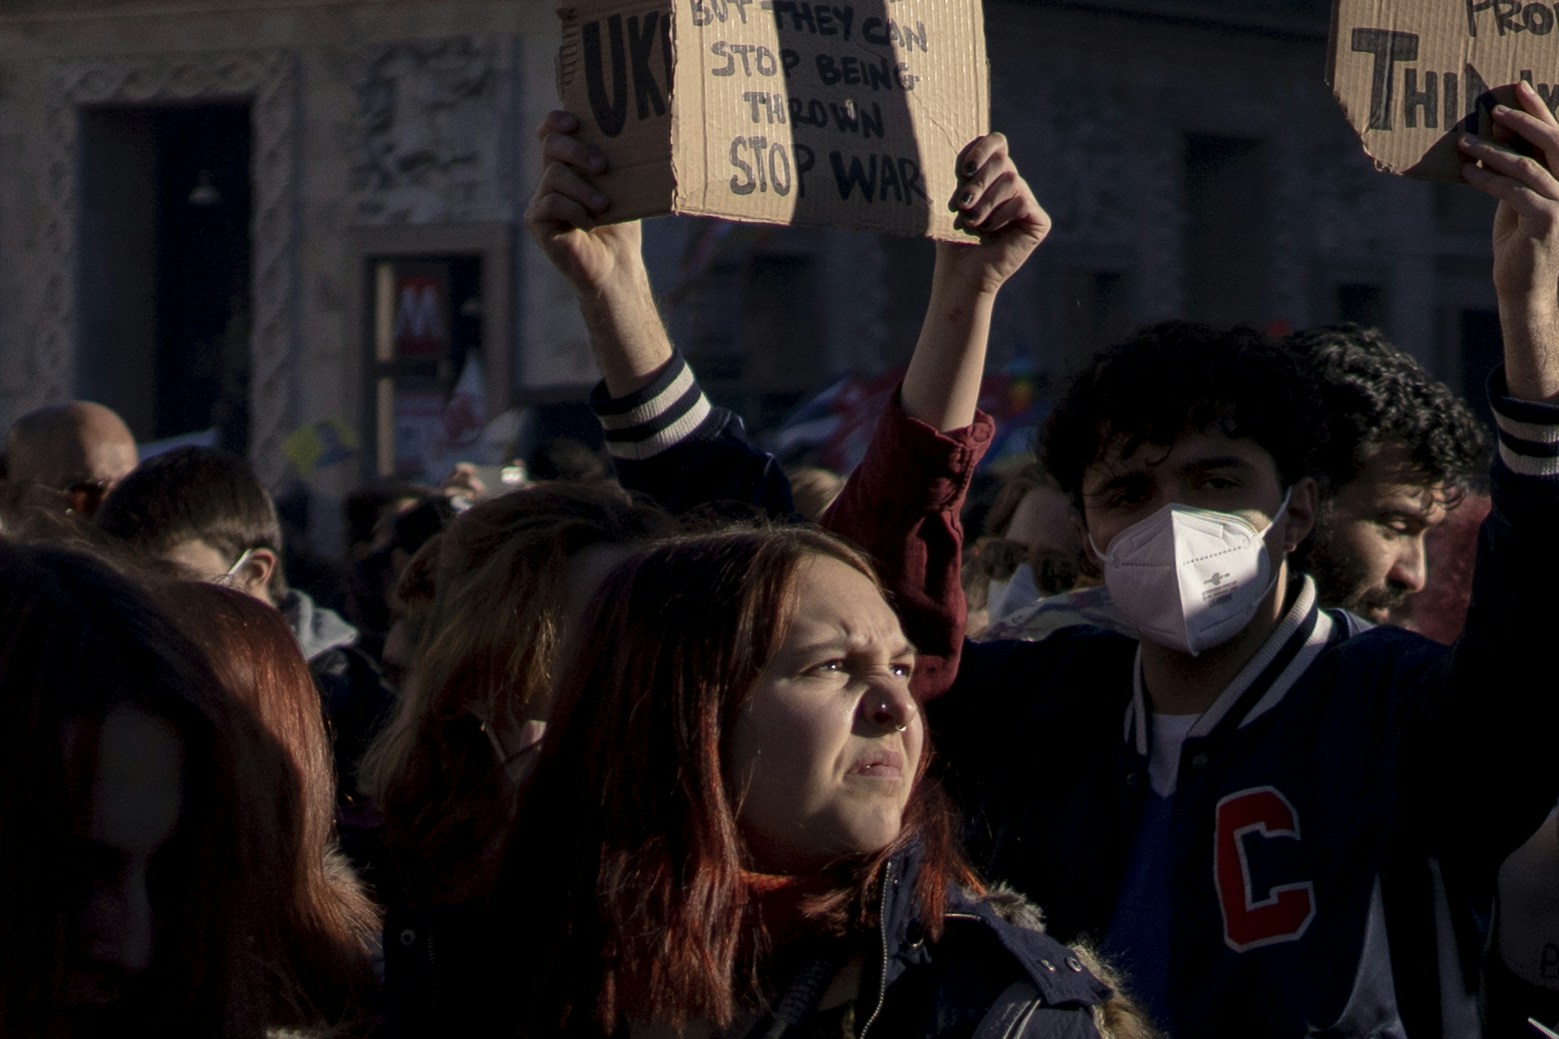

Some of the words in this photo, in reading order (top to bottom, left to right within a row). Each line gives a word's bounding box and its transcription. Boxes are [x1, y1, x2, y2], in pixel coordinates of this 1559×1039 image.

[761, 0, 854, 41] THEY
[862, 17, 928, 53] CAN
[711, 40, 799, 78] STOP
[815, 54, 920, 92] BEING
[743, 91, 885, 139] THROWN
[729, 135, 815, 198] STOP
[829, 150, 934, 206] WAR
[1213, 785, 1317, 954] C
